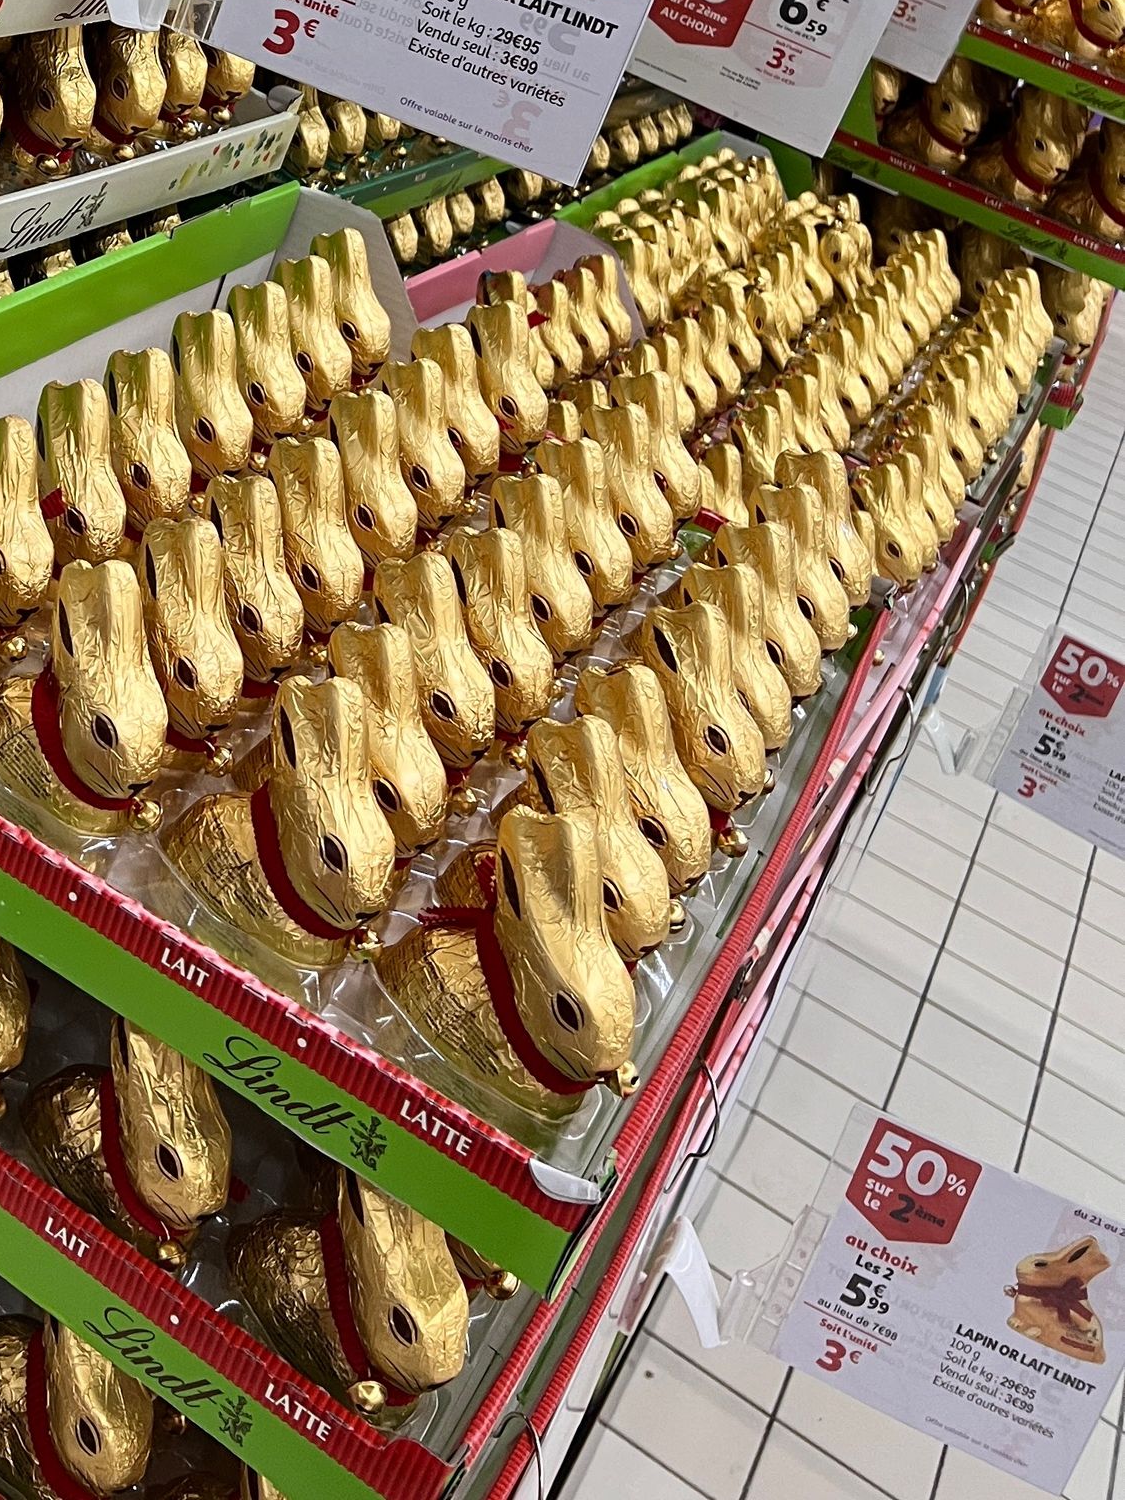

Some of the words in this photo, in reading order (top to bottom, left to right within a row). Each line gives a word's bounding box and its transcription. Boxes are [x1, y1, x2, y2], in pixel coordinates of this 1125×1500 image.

[422, 1, 451, 23] Soit
[452, 11, 465, 29] le
[467, 16, 486, 39] kg
[493, 27, 541, 55] 29€95
[562, 8, 619, 40] LINDT
[660, 7, 677, 20] AU
[679, 16, 718, 37] CHOIX
[696, 3, 728, 23] 2ème
[417, 18, 460, 47] Vendu
[462, 39, 491, 60] seul
[500, 50, 538, 75] 3€99
[408, 37, 450, 64] Existe
[451, 53, 507, 86] d'autres
[509, 77, 566, 107] variétés
[1054, 642, 1119, 688] 50%
[1055, 714, 1085, 738] choix
[160, 947, 209, 988] LAIT
[204, 1036, 354, 1136] Lindt
[399, 1100, 474, 1157] LATTE
[867, 1130, 967, 1196] 50%
[865, 1178, 894, 1197] sur
[845, 1235, 868, 1251] au
[870, 1246, 919, 1275] choix
[855, 1254, 880, 1275] Les
[882, 1267, 895, 1281] 2
[950, 1338, 972, 1354] 100
[972, 1351, 981, 1361] g
[956, 1324, 998, 1351] LAPIN
[999, 1344, 1019, 1362] OR
[1020, 1354, 1054, 1376] LAIT
[1053, 1367, 1096, 1396] LINDT
